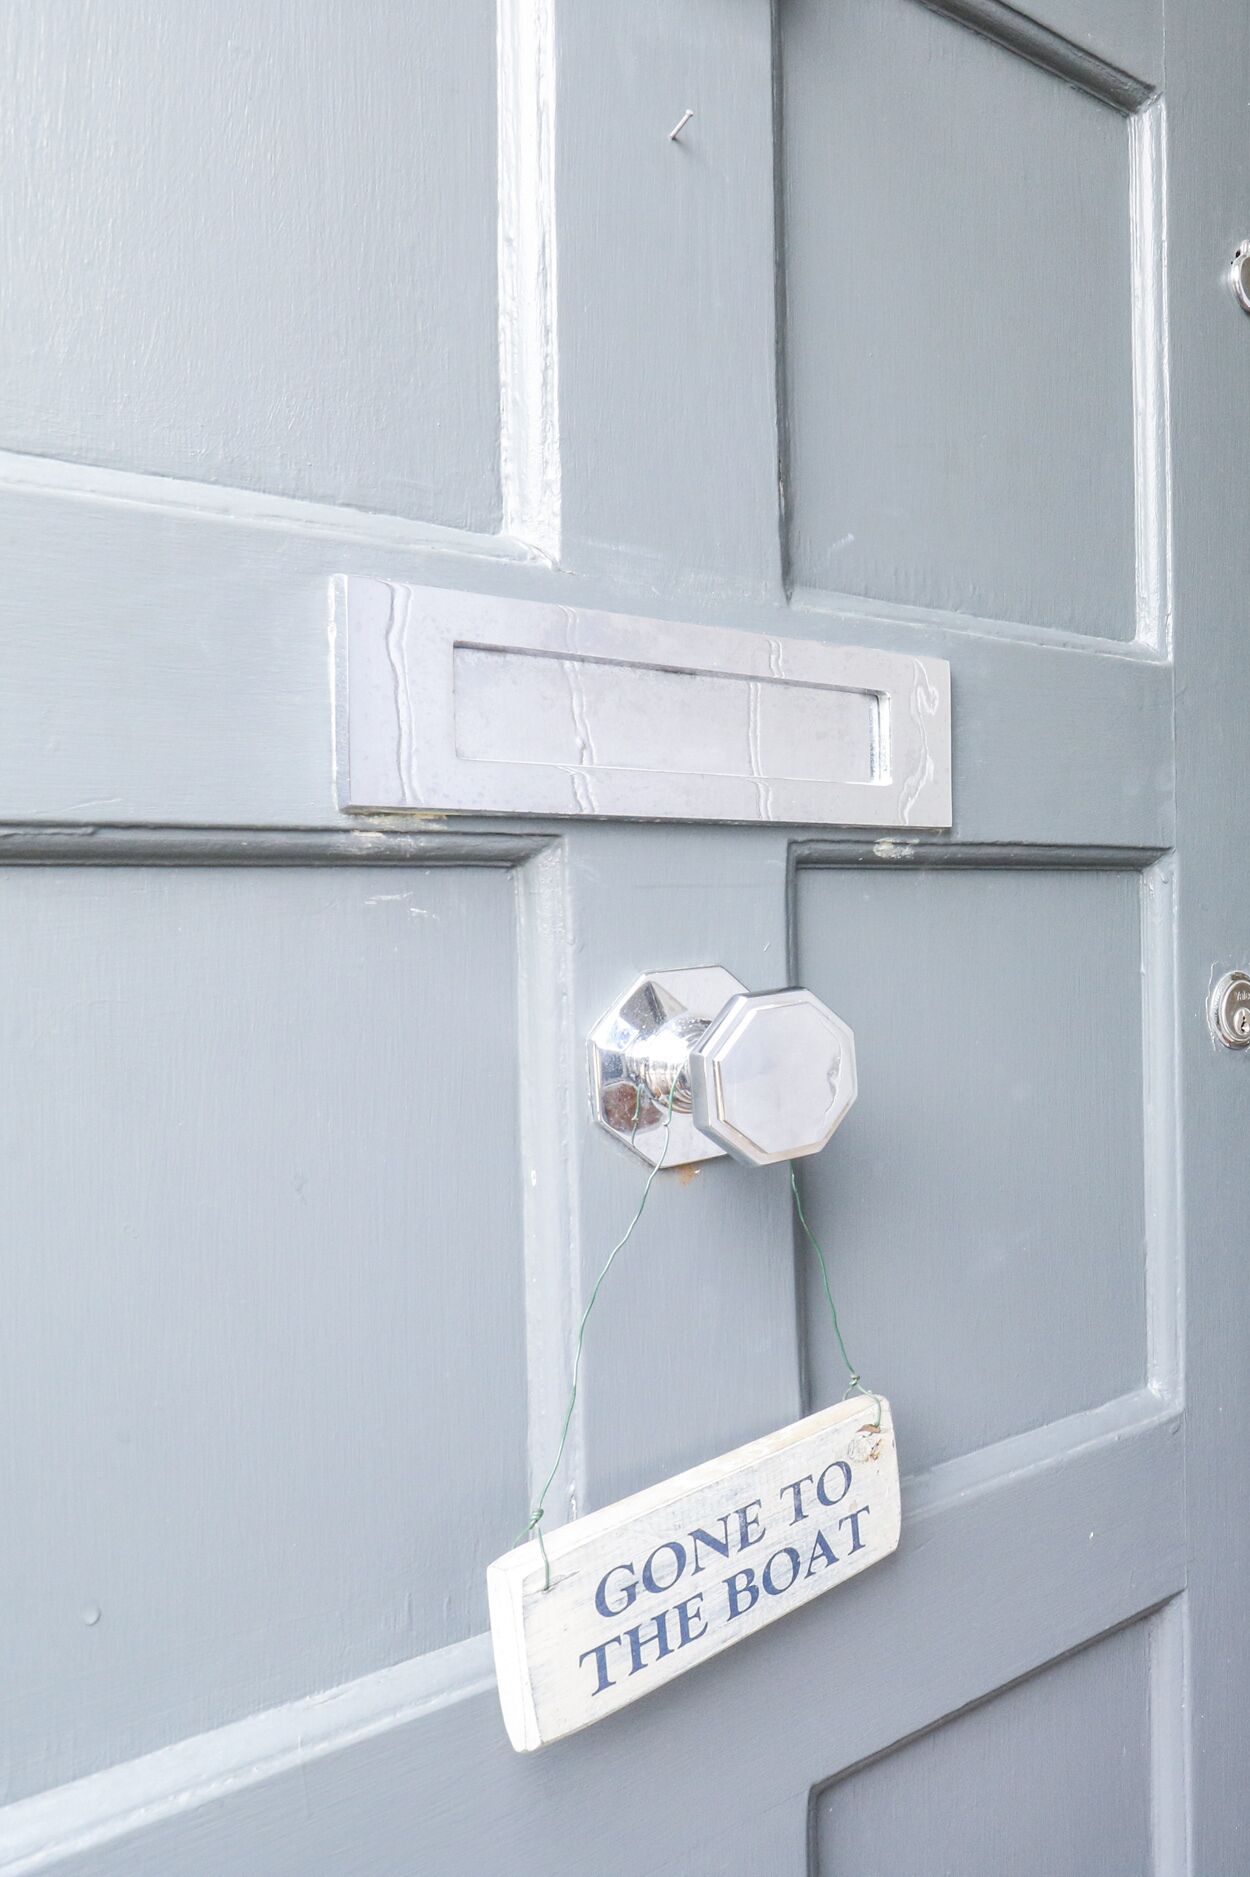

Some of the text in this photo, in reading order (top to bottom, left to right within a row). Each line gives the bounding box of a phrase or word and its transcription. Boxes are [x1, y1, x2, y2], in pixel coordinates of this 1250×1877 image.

[578, 1506, 871, 1697] THE BOAT
[595, 1460, 853, 1618] GONE TO
